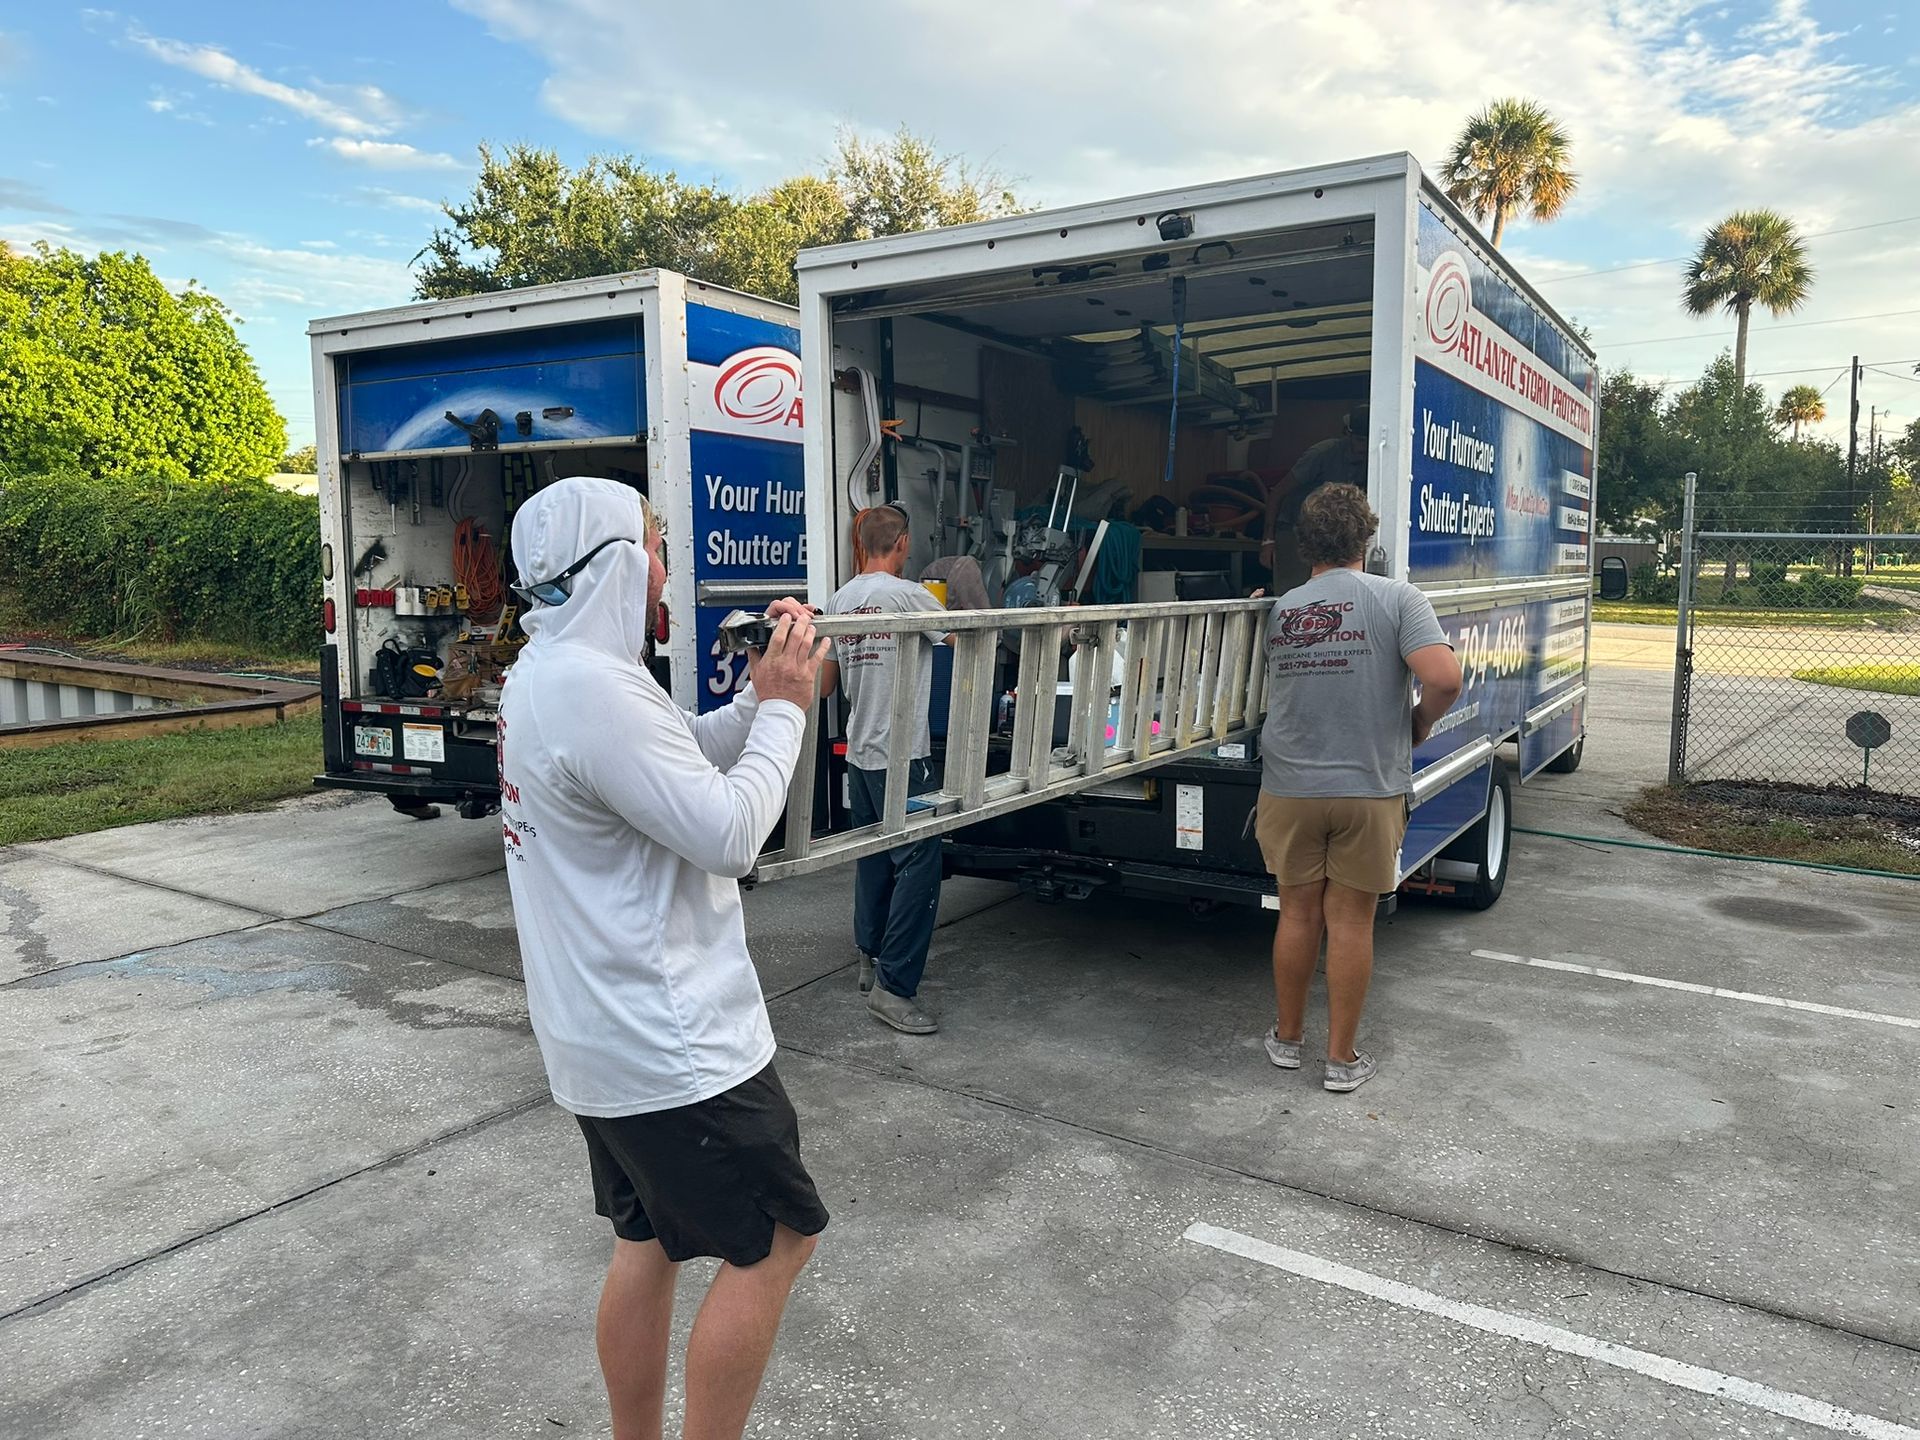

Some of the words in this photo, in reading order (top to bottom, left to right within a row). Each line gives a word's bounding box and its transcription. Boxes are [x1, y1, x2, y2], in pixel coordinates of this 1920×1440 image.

[1457, 320, 1517, 390] ATLANTIC
[1518, 362, 1550, 411] STORM
[1551, 385, 1591, 436] PROTECTION
[1423, 408, 1449, 461] Your
[1449, 420, 1494, 474] Hurricane
[705, 474, 759, 513] Your
[1419, 483, 1461, 534] Shutter
[1461, 493, 1495, 546] Experts
[707, 529, 791, 566] Shutter
[1313, 649, 1341, 657] SHUTTER
[1344, 648, 1372, 656] EXPERTS
